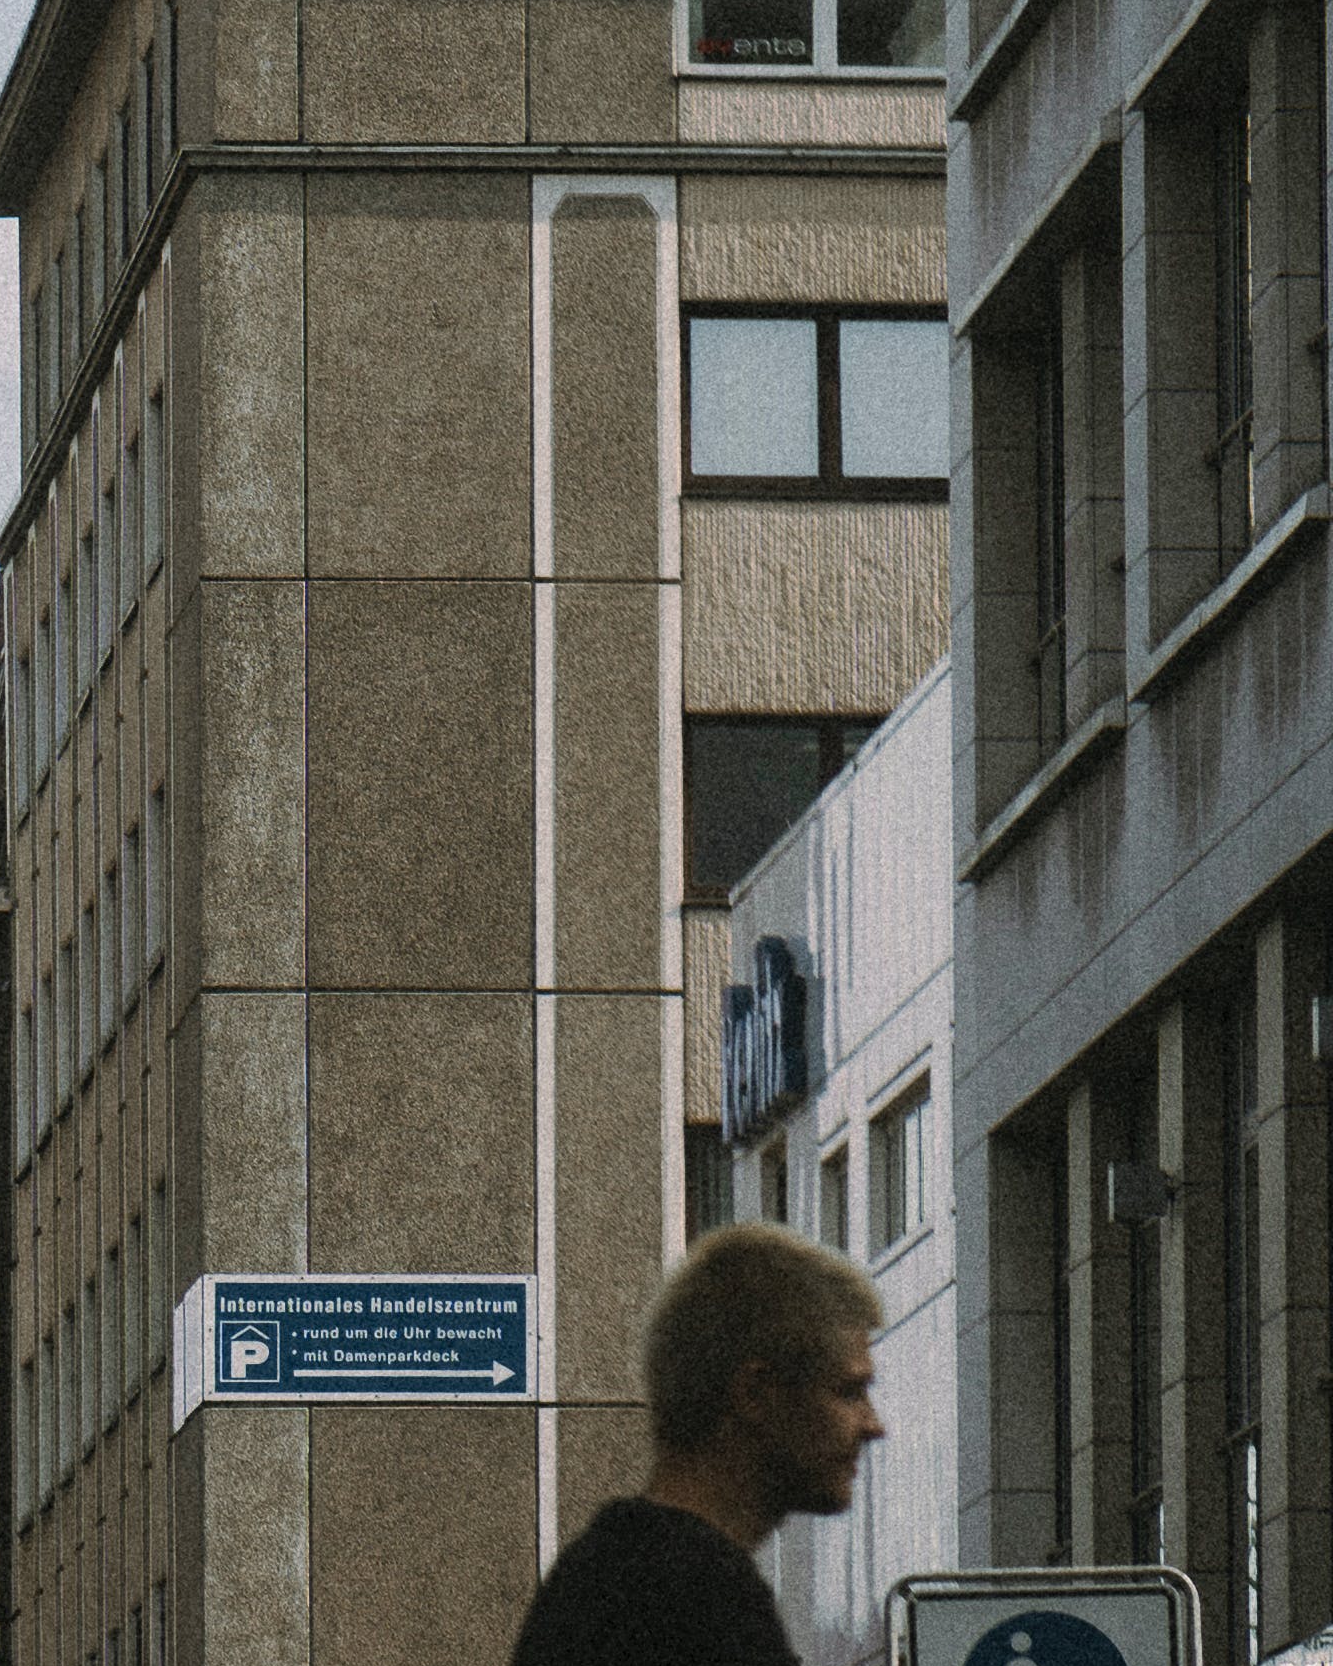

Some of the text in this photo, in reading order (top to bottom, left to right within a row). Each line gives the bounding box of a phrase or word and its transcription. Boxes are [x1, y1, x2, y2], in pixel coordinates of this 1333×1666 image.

[220, 1296, 518, 1313] Internationales Handelszentrum
[303, 1326, 502, 1339] rund um die Uhr bewacht
[303, 1349, 460, 1365] mit Damenparkdeck
